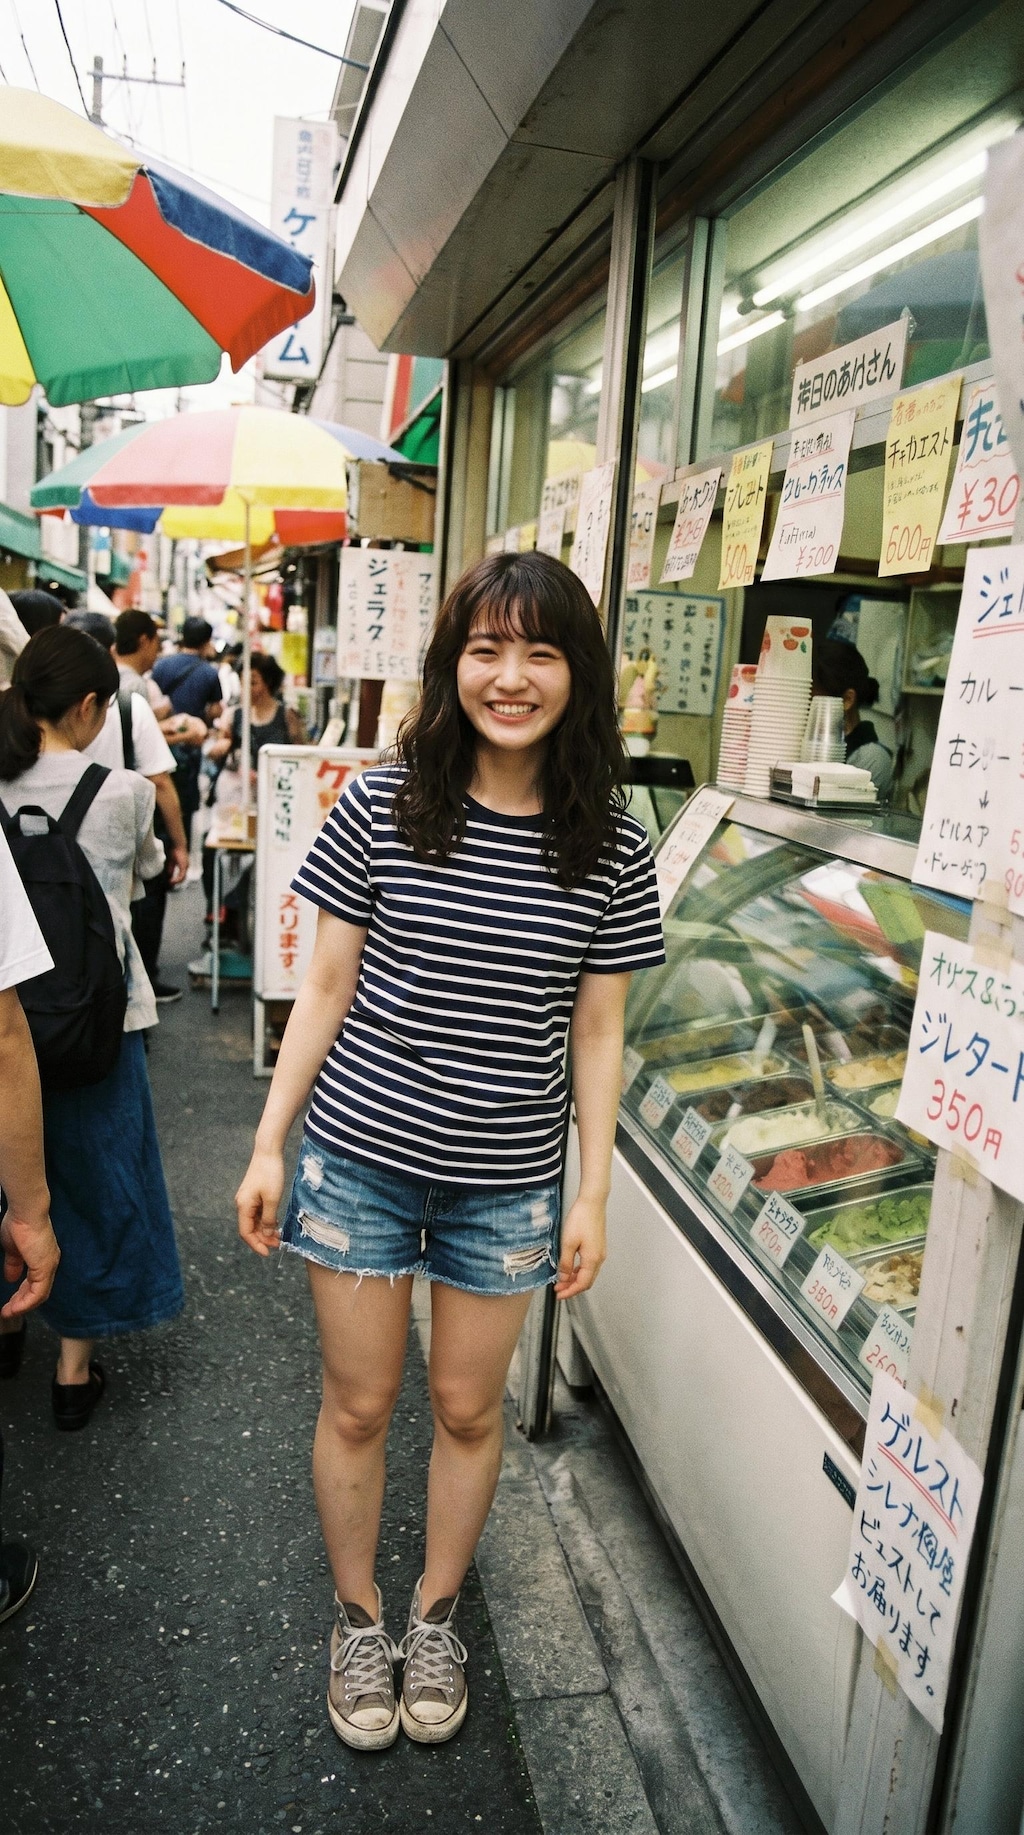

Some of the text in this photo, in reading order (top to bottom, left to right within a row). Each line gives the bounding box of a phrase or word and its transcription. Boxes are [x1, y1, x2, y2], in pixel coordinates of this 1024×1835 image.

[796, 544, 834, 573] ¥500
[886, 523, 932, 564] 600円
[927, 1079, 1002, 1160] 350円
